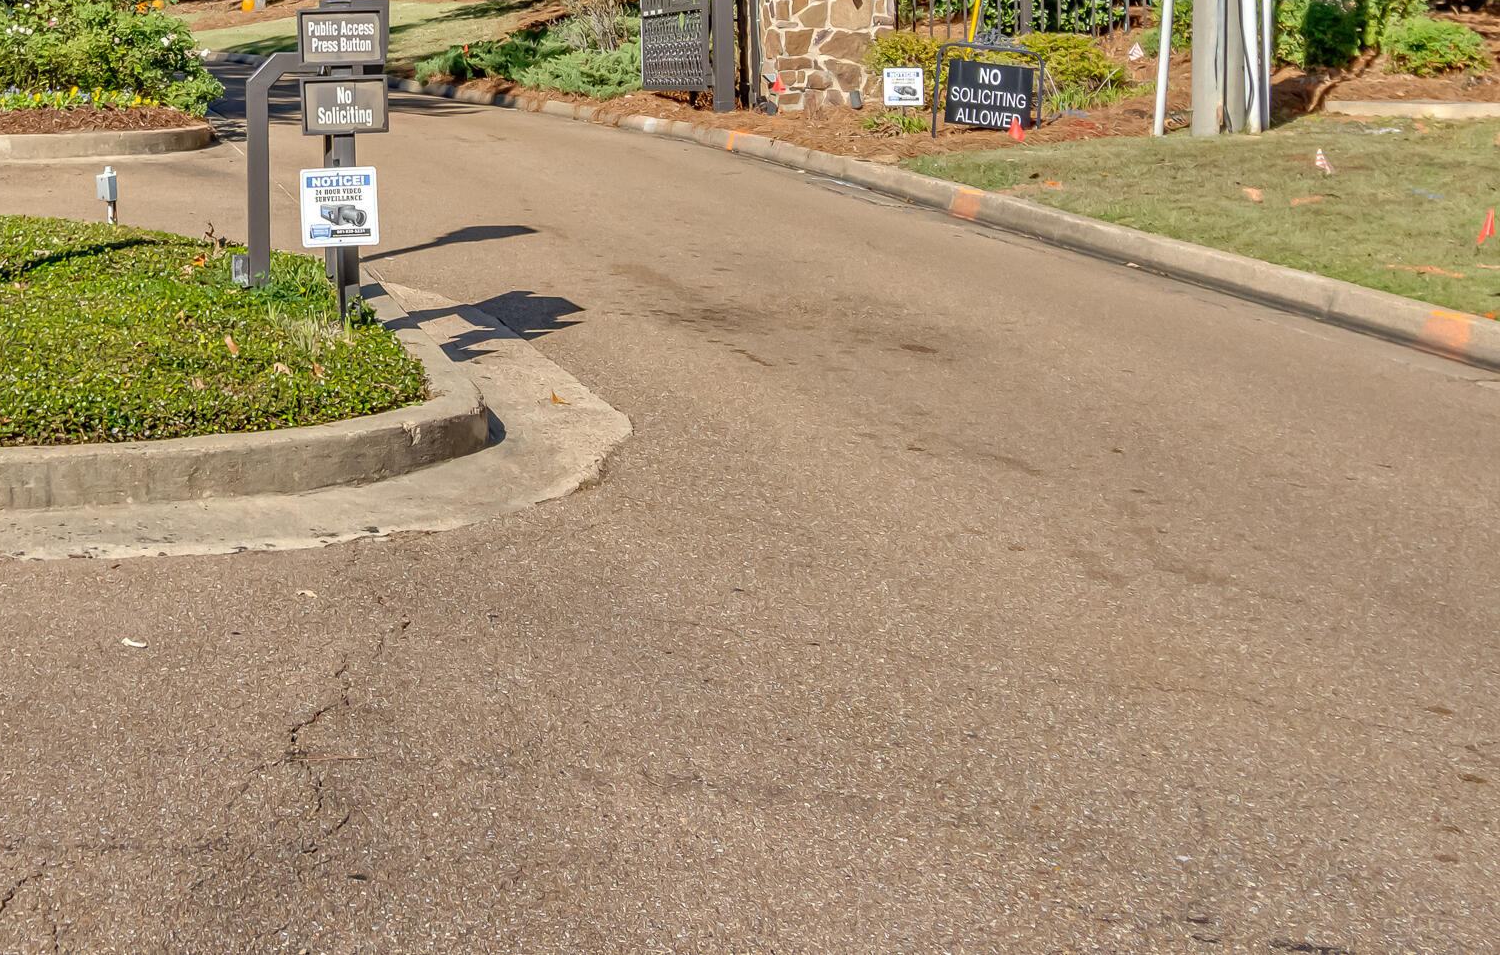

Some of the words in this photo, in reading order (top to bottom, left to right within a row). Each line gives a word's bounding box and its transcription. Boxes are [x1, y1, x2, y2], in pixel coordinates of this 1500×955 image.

[308, 21, 338, 36] Public
[340, 21, 375, 35] Access
[311, 38, 338, 52] Press
[340, 37, 372, 52] Button
[979, 67, 1002, 85] NO
[336, 86, 352, 104] No
[950, 86, 1027, 109] SOLICITING
[317, 106, 373, 126] Soliciting
[955, 107, 1022, 128] ALLOWED
[311, 175, 365, 187] NOTICE!
[315, 195, 363, 203] SURVEILLANCE
[342, 187, 362, 195] VIDEO
